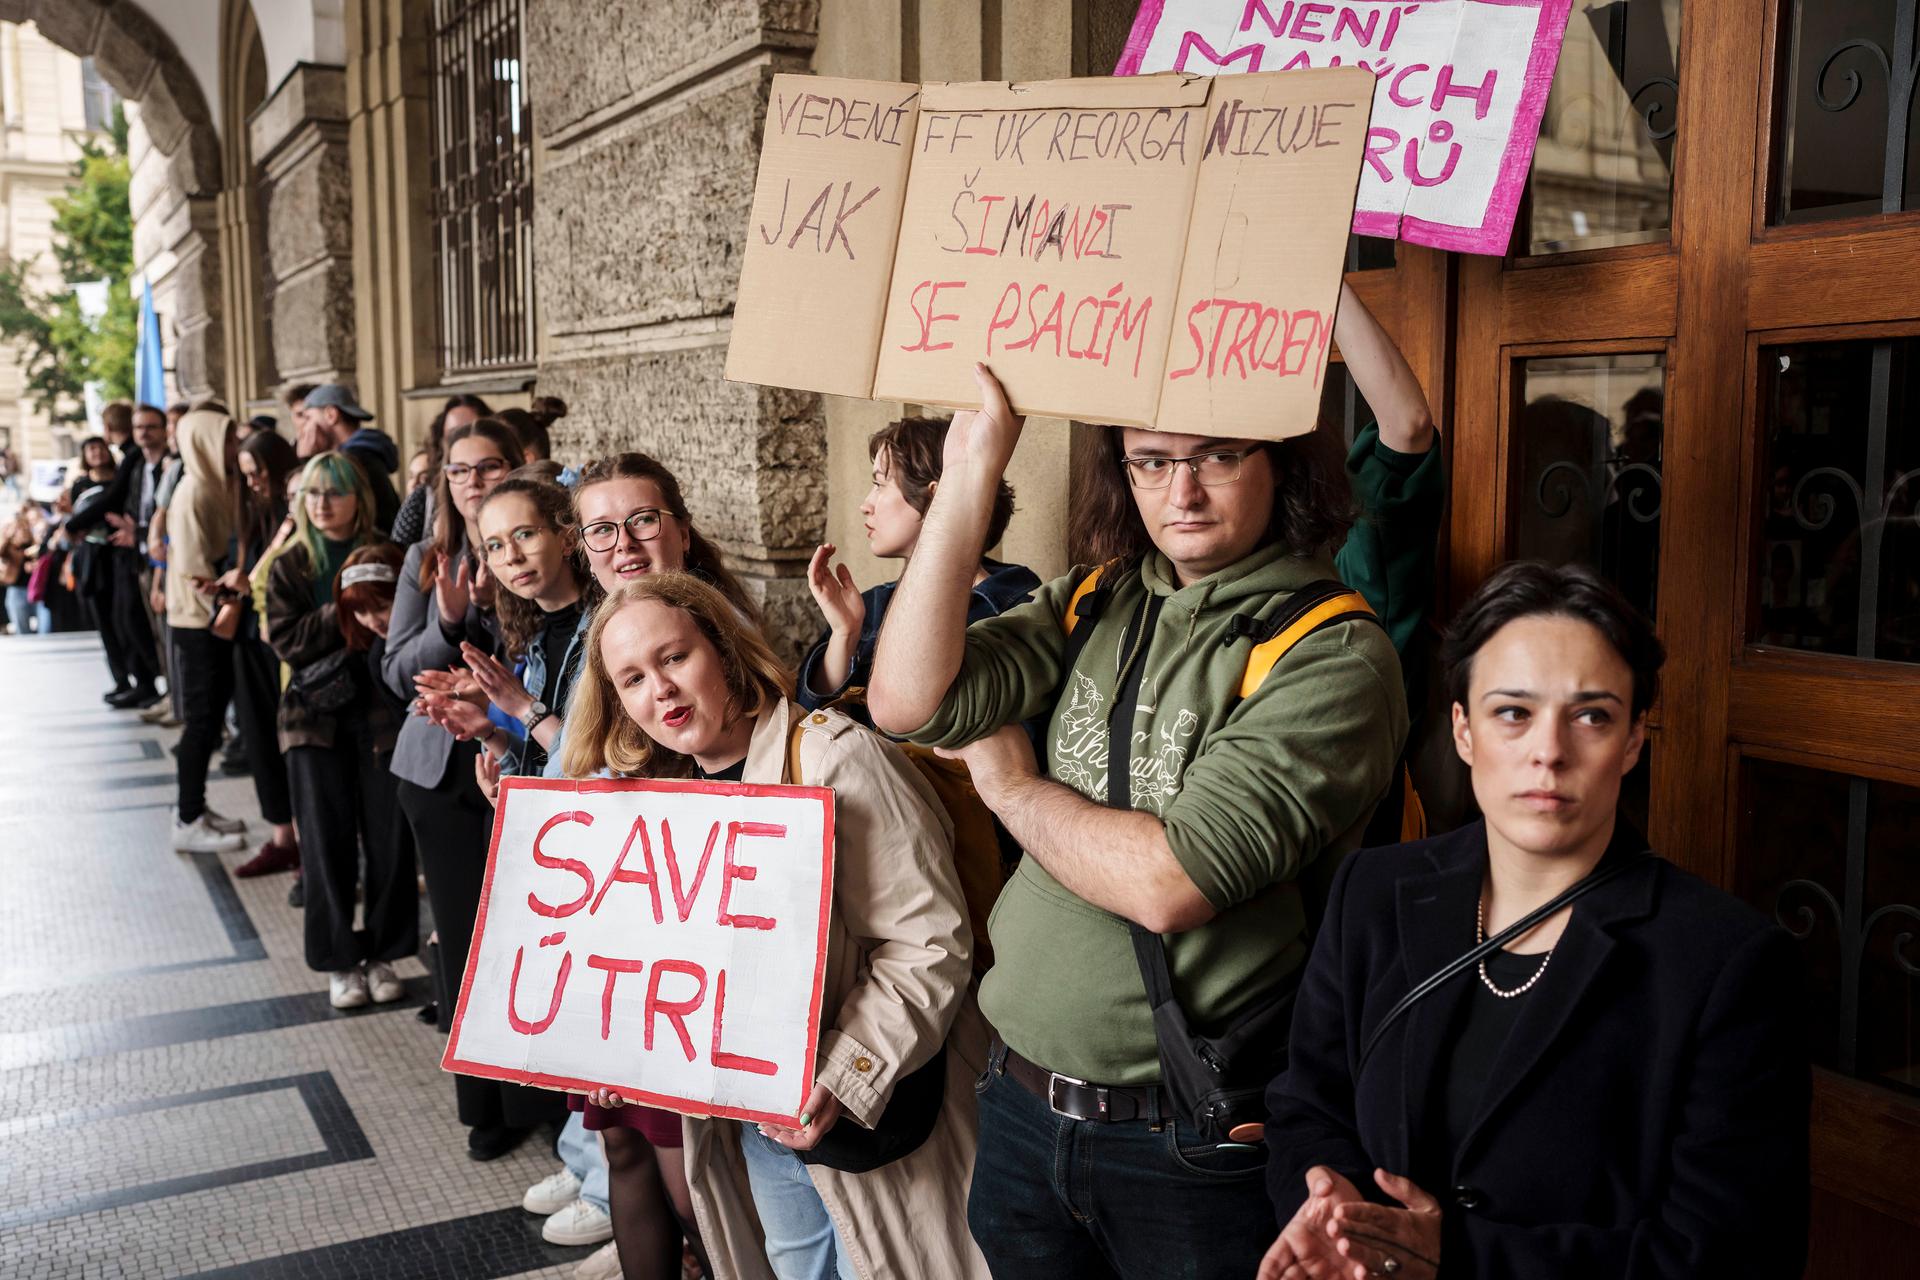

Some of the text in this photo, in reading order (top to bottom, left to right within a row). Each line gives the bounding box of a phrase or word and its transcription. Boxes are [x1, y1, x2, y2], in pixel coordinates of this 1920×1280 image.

[1239, 0, 1420, 52] NENÍ
[778, 92, 919, 146] VEDENÍ
[923, 113, 983, 153] FF
[994, 111, 1047, 165] UK
[760, 178, 881, 260] JAK
[936, 167, 1132, 263] ŠIMPANZI
[900, 280, 1334, 390] SE PSACÍM STROJEM
[527, 810, 788, 930] SAVE
[507, 931, 779, 1076] ÚTRL
